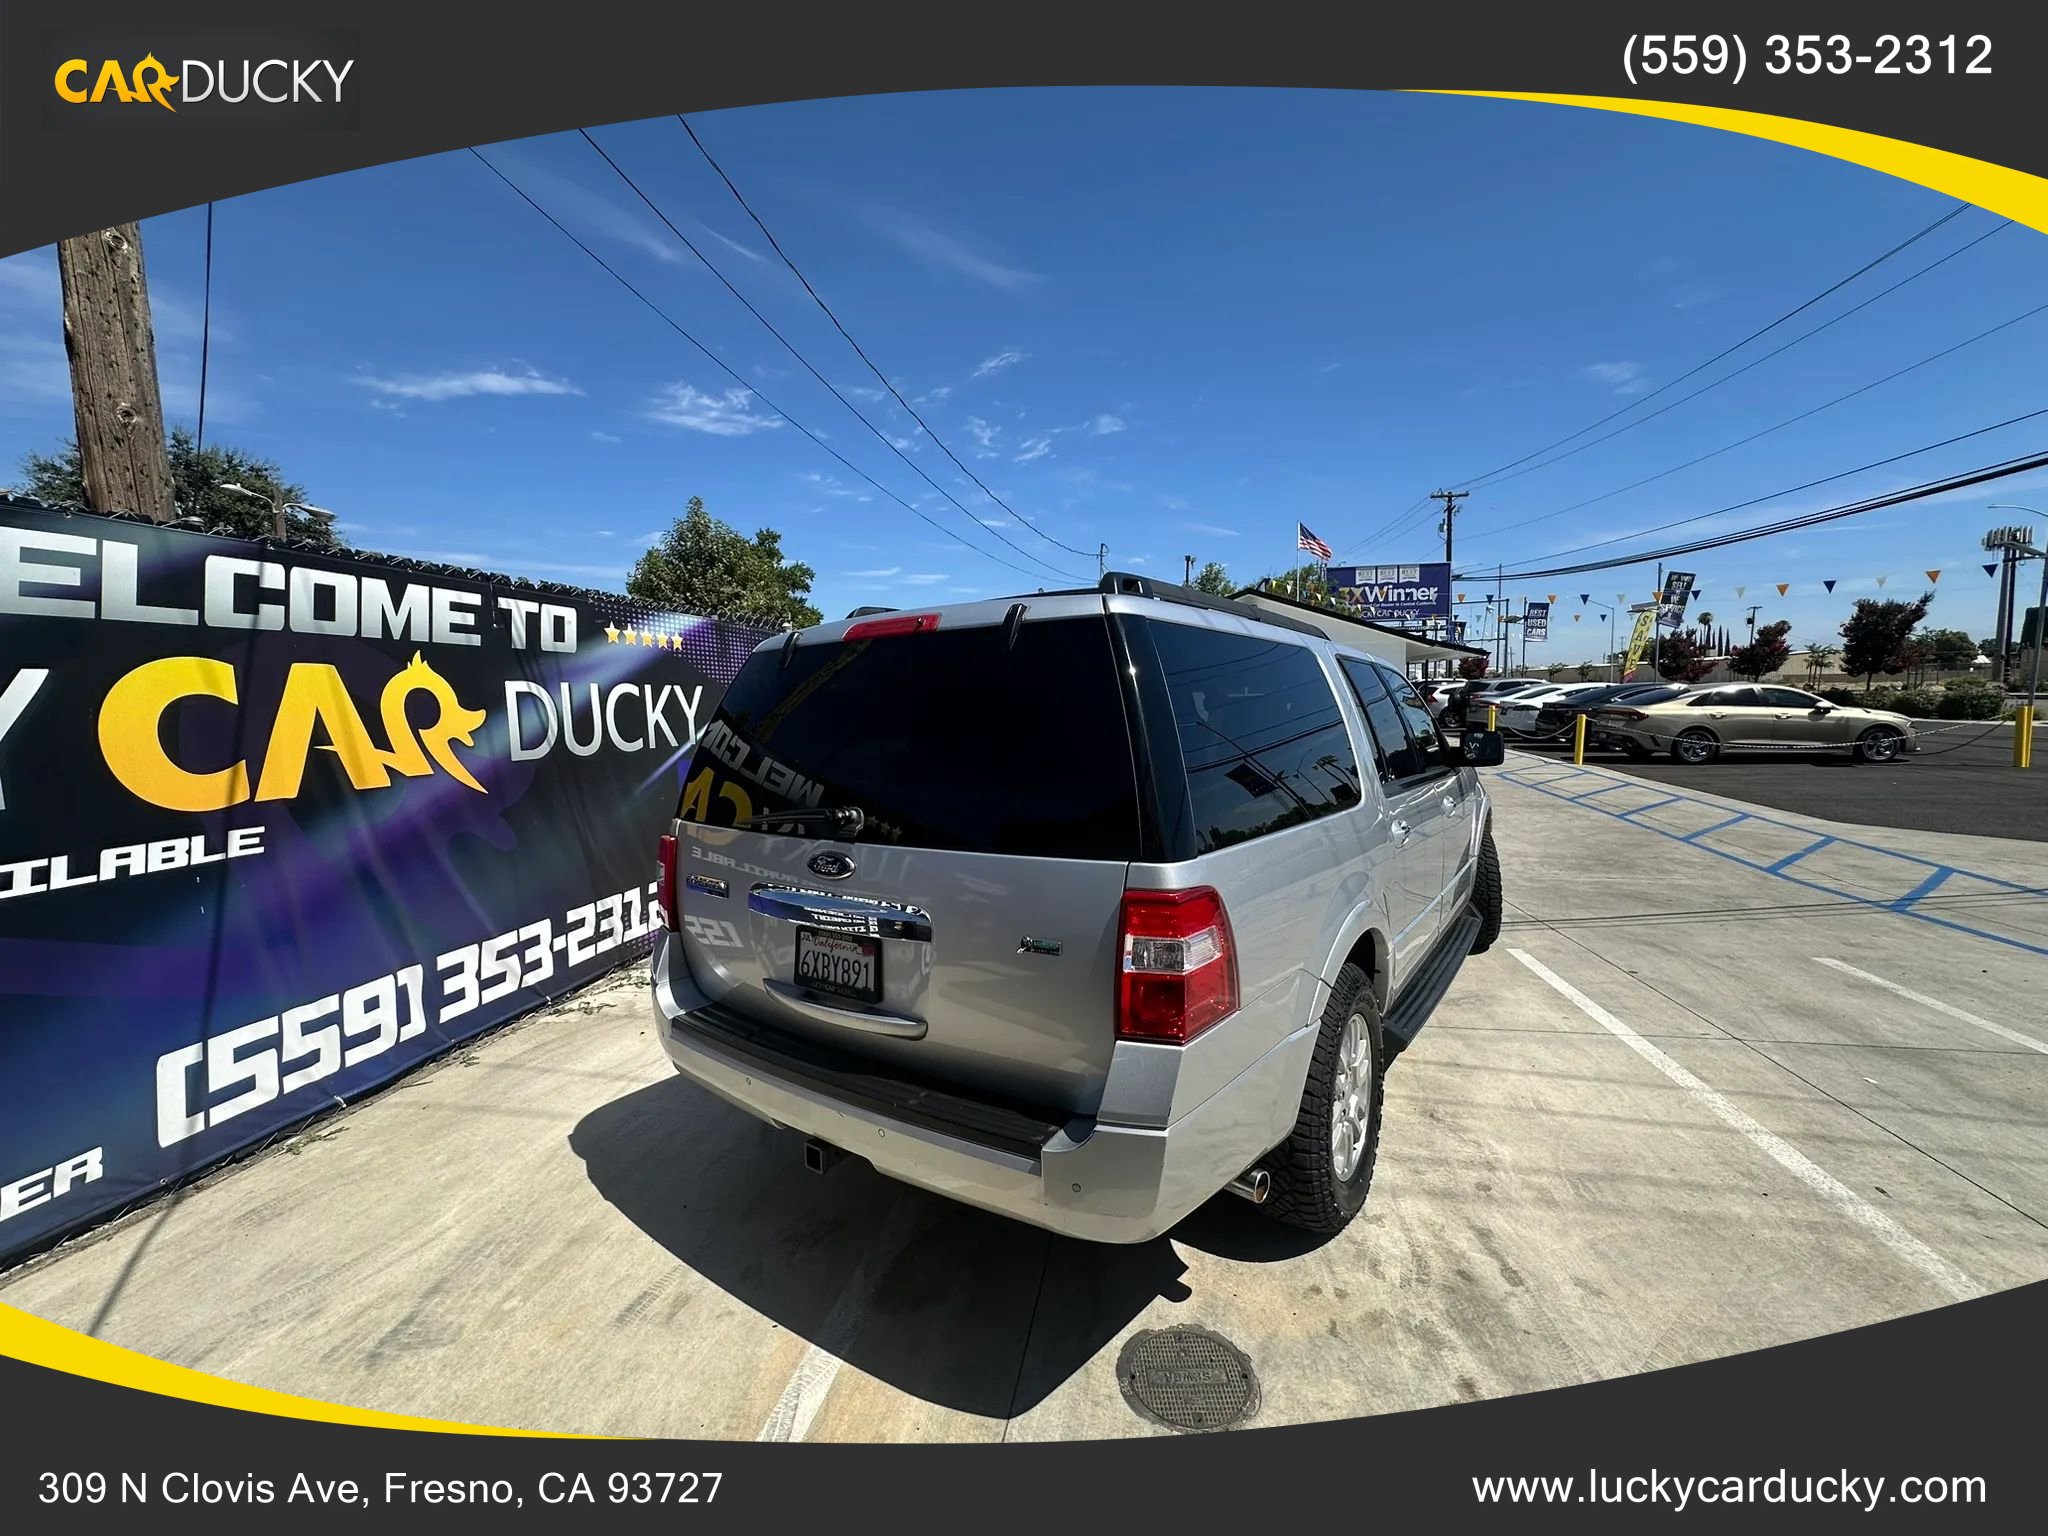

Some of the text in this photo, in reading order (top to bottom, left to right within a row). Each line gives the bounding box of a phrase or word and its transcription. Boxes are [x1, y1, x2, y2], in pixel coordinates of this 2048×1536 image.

[0, 526, 578, 653] ELCOME TO
[1527, 618, 1547, 627] USED
[1529, 609, 1547, 618] BEST
[1526, 628, 1546, 636] CARS
[1629, 615, 1650, 670] SAVE
[98, 650, 488, 812] CAR
[505, 680, 703, 762] DUCKY
[0, 826, 265, 899] ILABLE
[812, 855, 839, 873] Ford
[814, 936, 862, 955] California
[801, 950, 873, 990] 6XBY891
